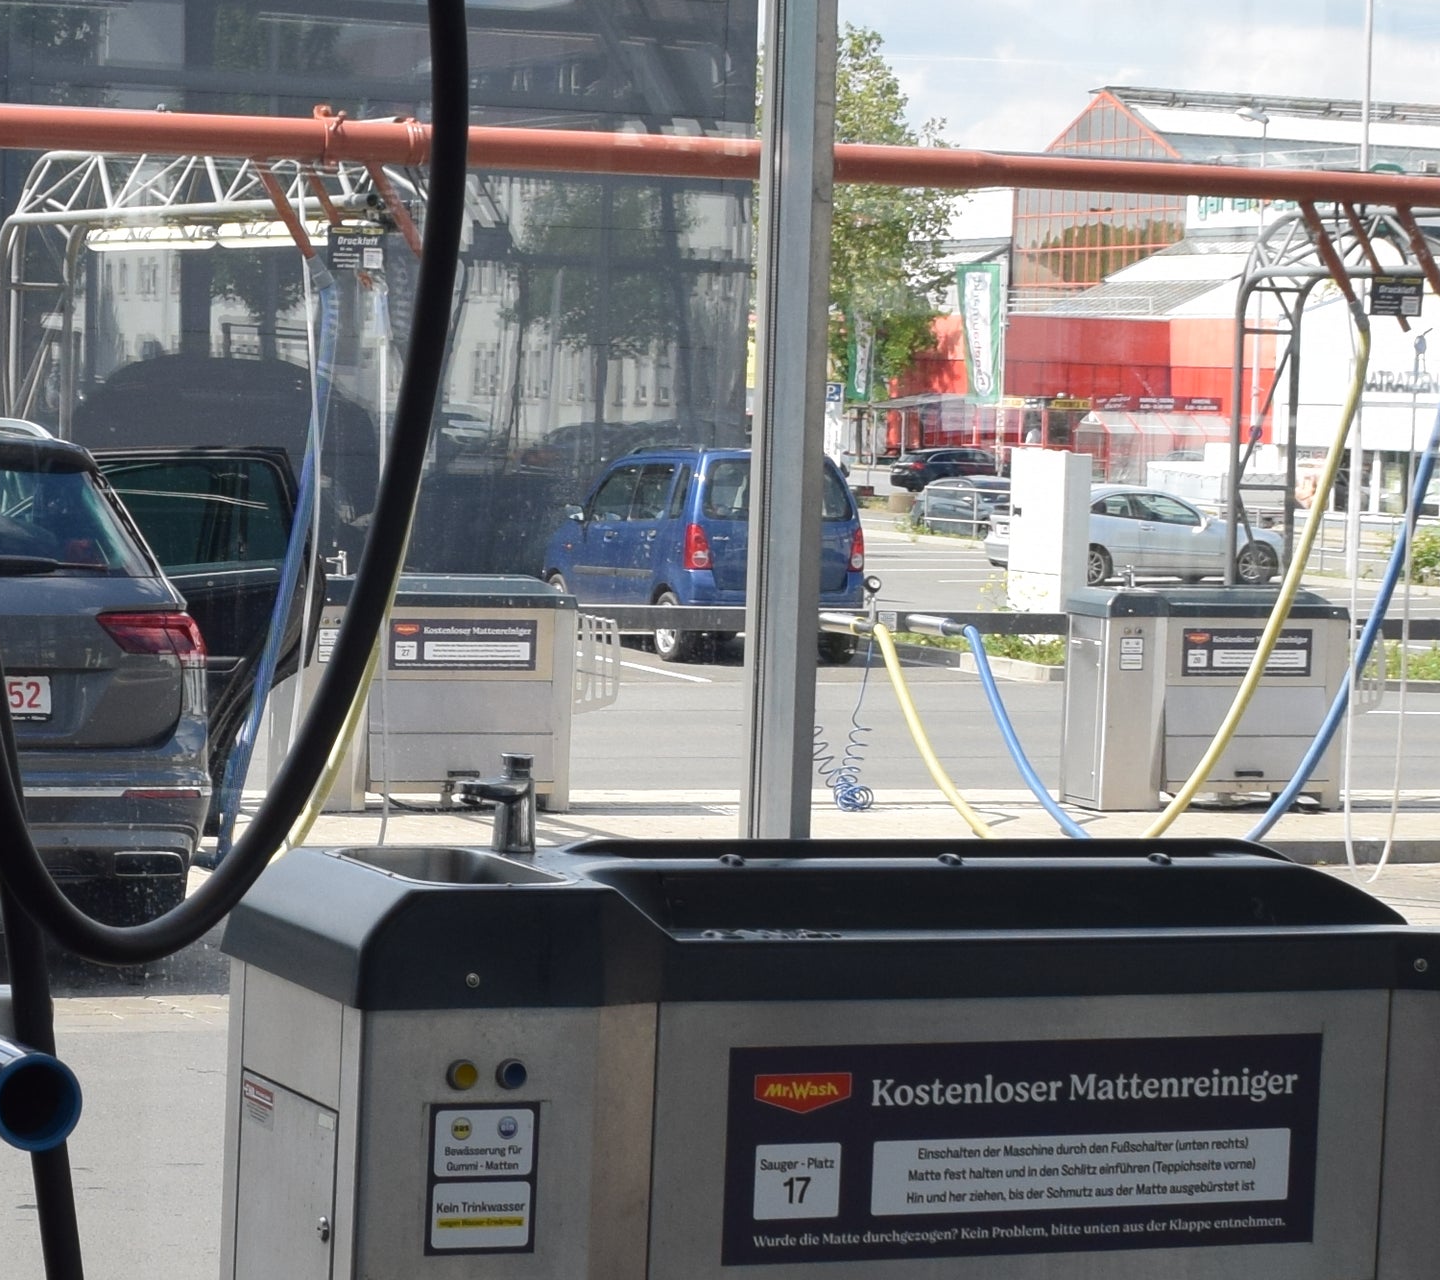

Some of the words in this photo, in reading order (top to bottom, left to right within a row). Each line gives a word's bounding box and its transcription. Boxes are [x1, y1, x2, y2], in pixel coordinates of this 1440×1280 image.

[423, 626, 471, 635] Kostenloser
[472, 627, 531, 636] Mattenreiniger
[401, 649, 410, 657] 27
[871, 1074, 1062, 1106] Kostenloser
[1069, 1068, 1298, 1103] Mattenreiniger
[444, 1145, 506, 1157] Bewässerung
[507, 1145, 522, 1156] für
[918, 1147, 981, 1160] Einschalten
[983, 1147, 1001, 1158] der
[1003, 1144, 1054, 1157] Maschine
[1056, 1143, 1087, 1155] durch
[1089, 1142, 1109, 1154] den
[1111, 1140, 1174, 1153] Fußschalter
[1175, 1139, 1210, 1153] (unten
[1211, 1137, 1249, 1150] rechts)
[446, 1161, 478, 1172] Gummi
[485, 1160, 519, 1171] Matten
[760, 1159, 798, 1172] Sauger
[807, 1157, 835, 1169] Platz
[908, 1169, 941, 1182] Matte
[944, 1168, 967, 1180] fest
[969, 1167, 1004, 1179] halten
[1006, 1165, 1026, 1178] und
[1028, 1165, 1037, 1177] in
[1039, 1165, 1059, 1177] den
[1061, 1163, 1097, 1176] Schlitz
[1099, 1161, 1150, 1174] einführen
[1152, 1159, 1221, 1174] (Teppichseite
[1224, 1158, 1256, 1171] vorne)
[783, 1177, 811, 1204] 17
[906, 1192, 924, 1204] Hin
[926, 1191, 947, 1203] und
[949, 1190, 966, 1202] her
[969, 1189, 1007, 1202] ziehen,
[1009, 1188, 1024, 1200] bis
[1026, 1187, 1044, 1199] der
[1046, 1185, 1093, 1198] Schmutz
[1095, 1187, 1114, 1197] aus
[1116, 1185, 1134, 1197] der
[1136, 1183, 1167, 1195] Matte
[1170, 1181, 1239, 1196] ausgebürstet
[1241, 1180, 1255, 1192] ist
[436, 1202, 459, 1213] Kein
[462, 1201, 525, 1213] Trinkwasser
[752, 1234, 797, 1248] Wurde
[799, 1233, 819, 1245] die
[822, 1232, 860, 1245] Matte
[862, 1228, 958, 1245] durchgezogen?
[961, 1226, 988, 1239] Kein
[992, 1224, 1048, 1238] Problem,
[1051, 1222, 1080, 1235] bitte
[1083, 1222, 1120, 1234] unten
[1123, 1223, 1144, 1233] aus
[1146, 1219, 1167, 1232] der
[1169, 1217, 1212, 1233] Klappe
[1214, 1215, 1286, 1229] entnehmen.
